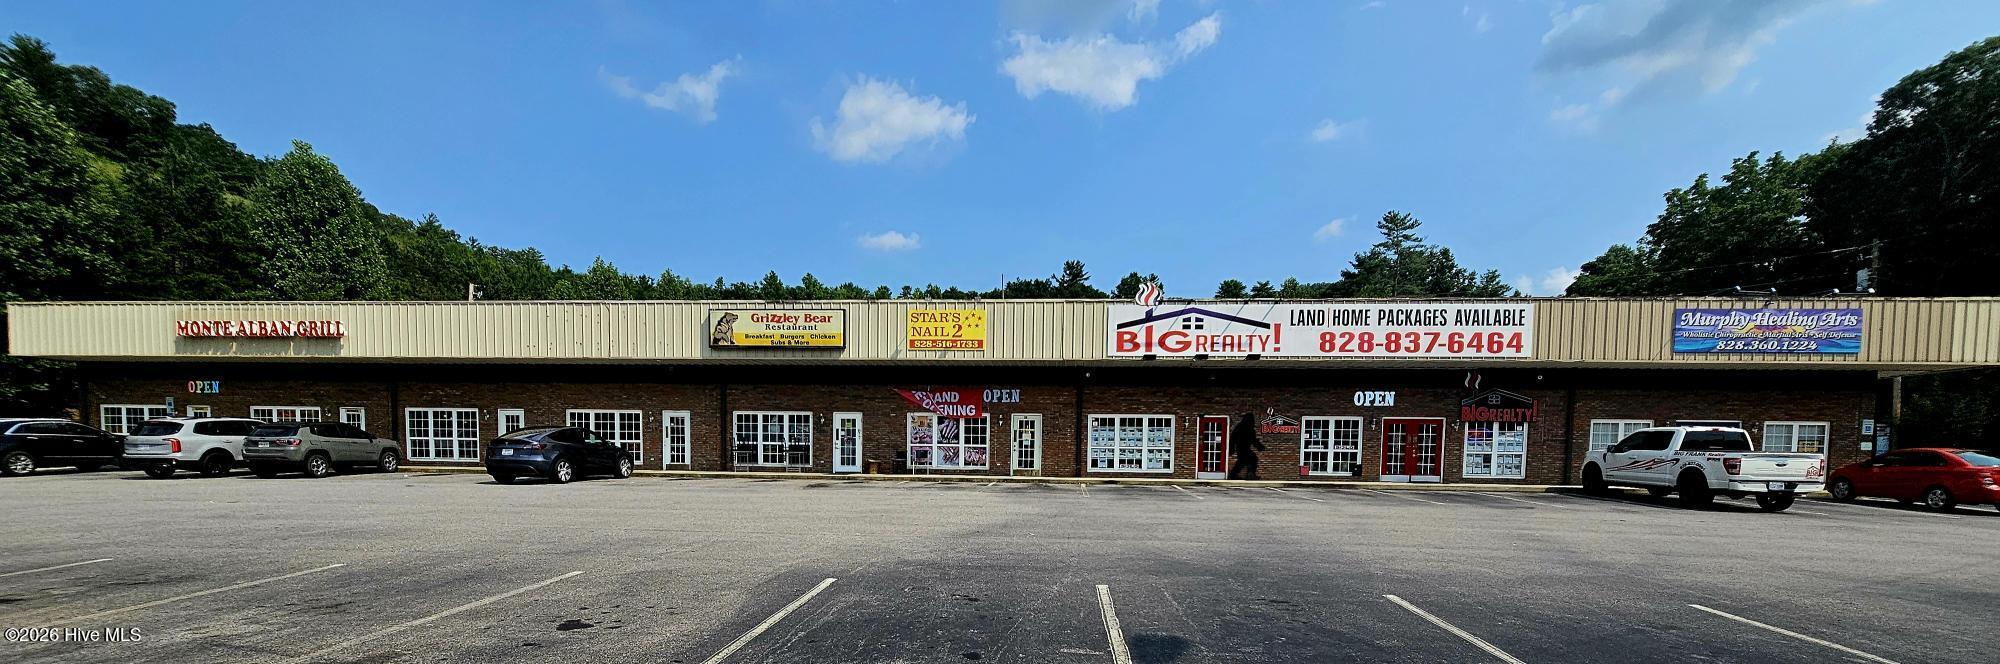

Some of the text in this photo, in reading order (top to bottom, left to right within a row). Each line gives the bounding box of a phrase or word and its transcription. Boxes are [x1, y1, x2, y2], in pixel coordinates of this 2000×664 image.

[803, 313, 833, 323] Bear
[910, 312, 961, 323] STAR'S
[1377, 308, 1448, 327] PACKAGES
[1454, 308, 1526, 326] AVAILABLE
[1680, 310, 1858, 330] Murphy Healing Arts
[176, 320, 345, 337] MONTE ALBAN GRILL
[765, 323, 818, 331] Restaurant
[911, 323, 963, 338] NAIL 2
[1714, 331, 1757, 339] Chiropractic
[914, 340, 979, 348] 828-516-1733
[1318, 331, 1524, 354] 828-837-6464
[1716, 340, 1818, 350] 828.360.1224
[188, 380, 220, 393] OPEN
[934, 391, 960, 403] AND
[983, 389, 1020, 403] OPEN
[1353, 391, 1396, 407] OPEN
